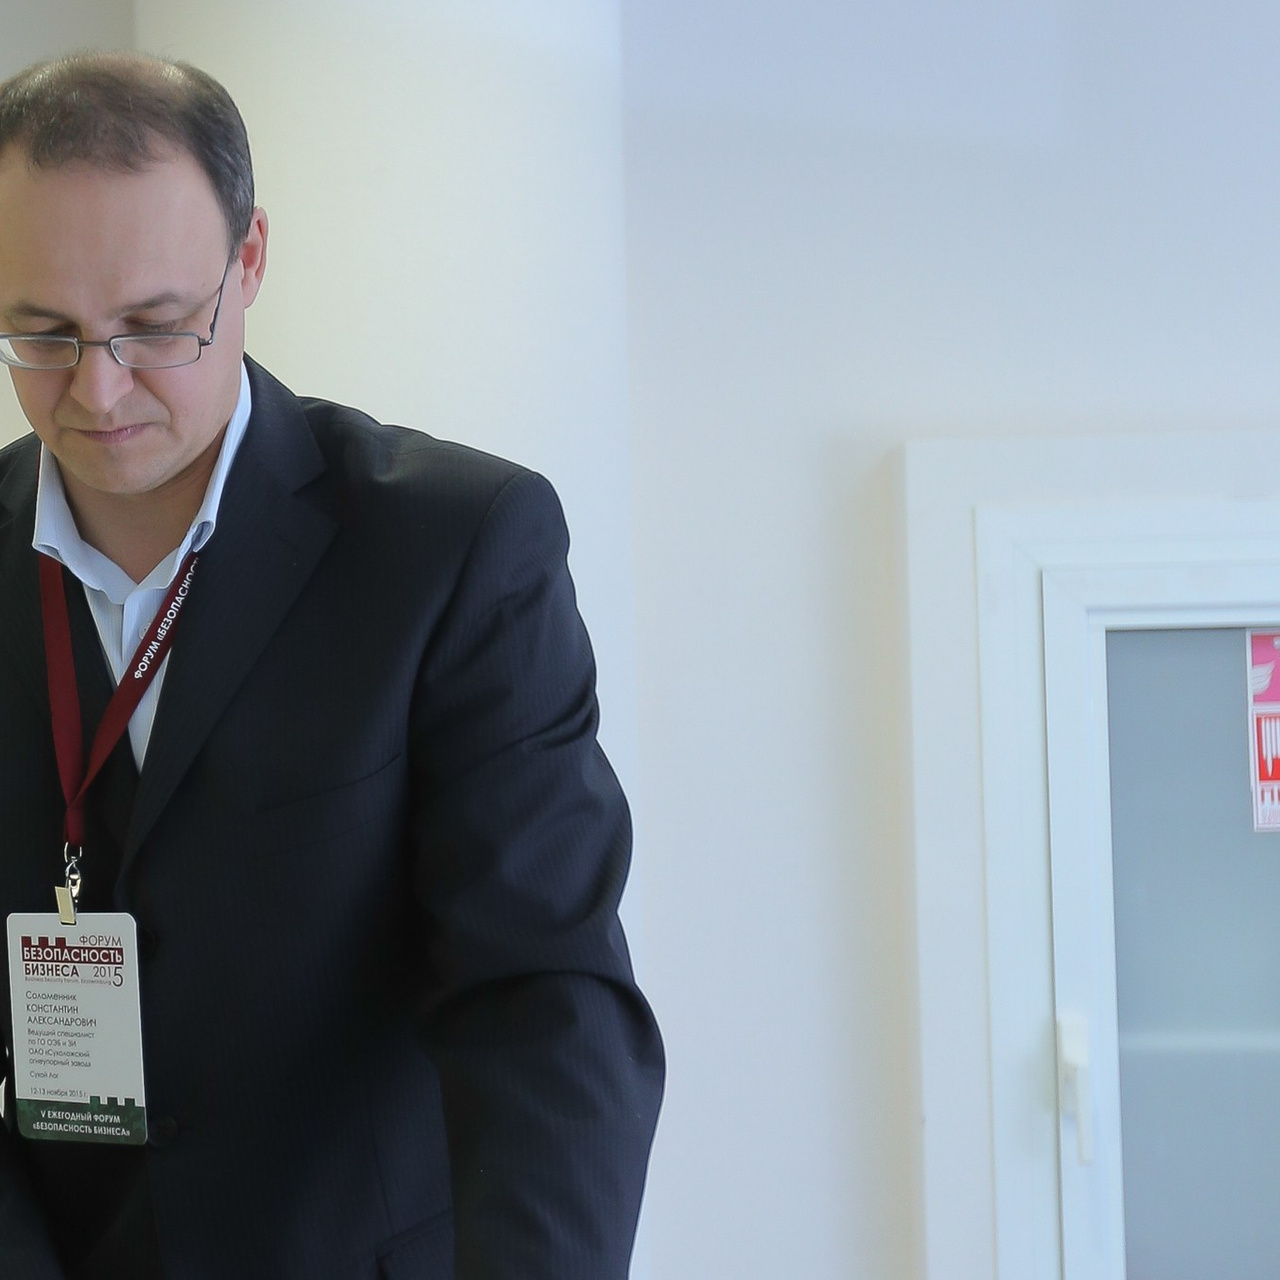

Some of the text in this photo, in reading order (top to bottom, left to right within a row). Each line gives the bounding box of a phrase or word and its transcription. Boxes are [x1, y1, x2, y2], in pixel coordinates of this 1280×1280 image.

[134, 640, 161, 679] ФОРУМ
[79, 935, 123, 947] ФОРУМ
[23, 947, 123, 963] БЕЗОПАСНОСТЬ
[24, 963, 124, 987] БИЗНЕСА 2015
[26, 1003, 79, 1014] КОНСТАНТИН
[27, 1015, 97, 1027] АЛЕКСАНДРОВИЧ
[29, 1047, 44, 1055] ОАО
[69, 1090, 83, 1098] 2015
[40, 1110, 121, 1124] V ЕЖЕГОДНЫЙ ФОРУМ
[33, 1121, 131, 1136] «БЕЗОПАСНОСТЬ БИЗНЕСА»
